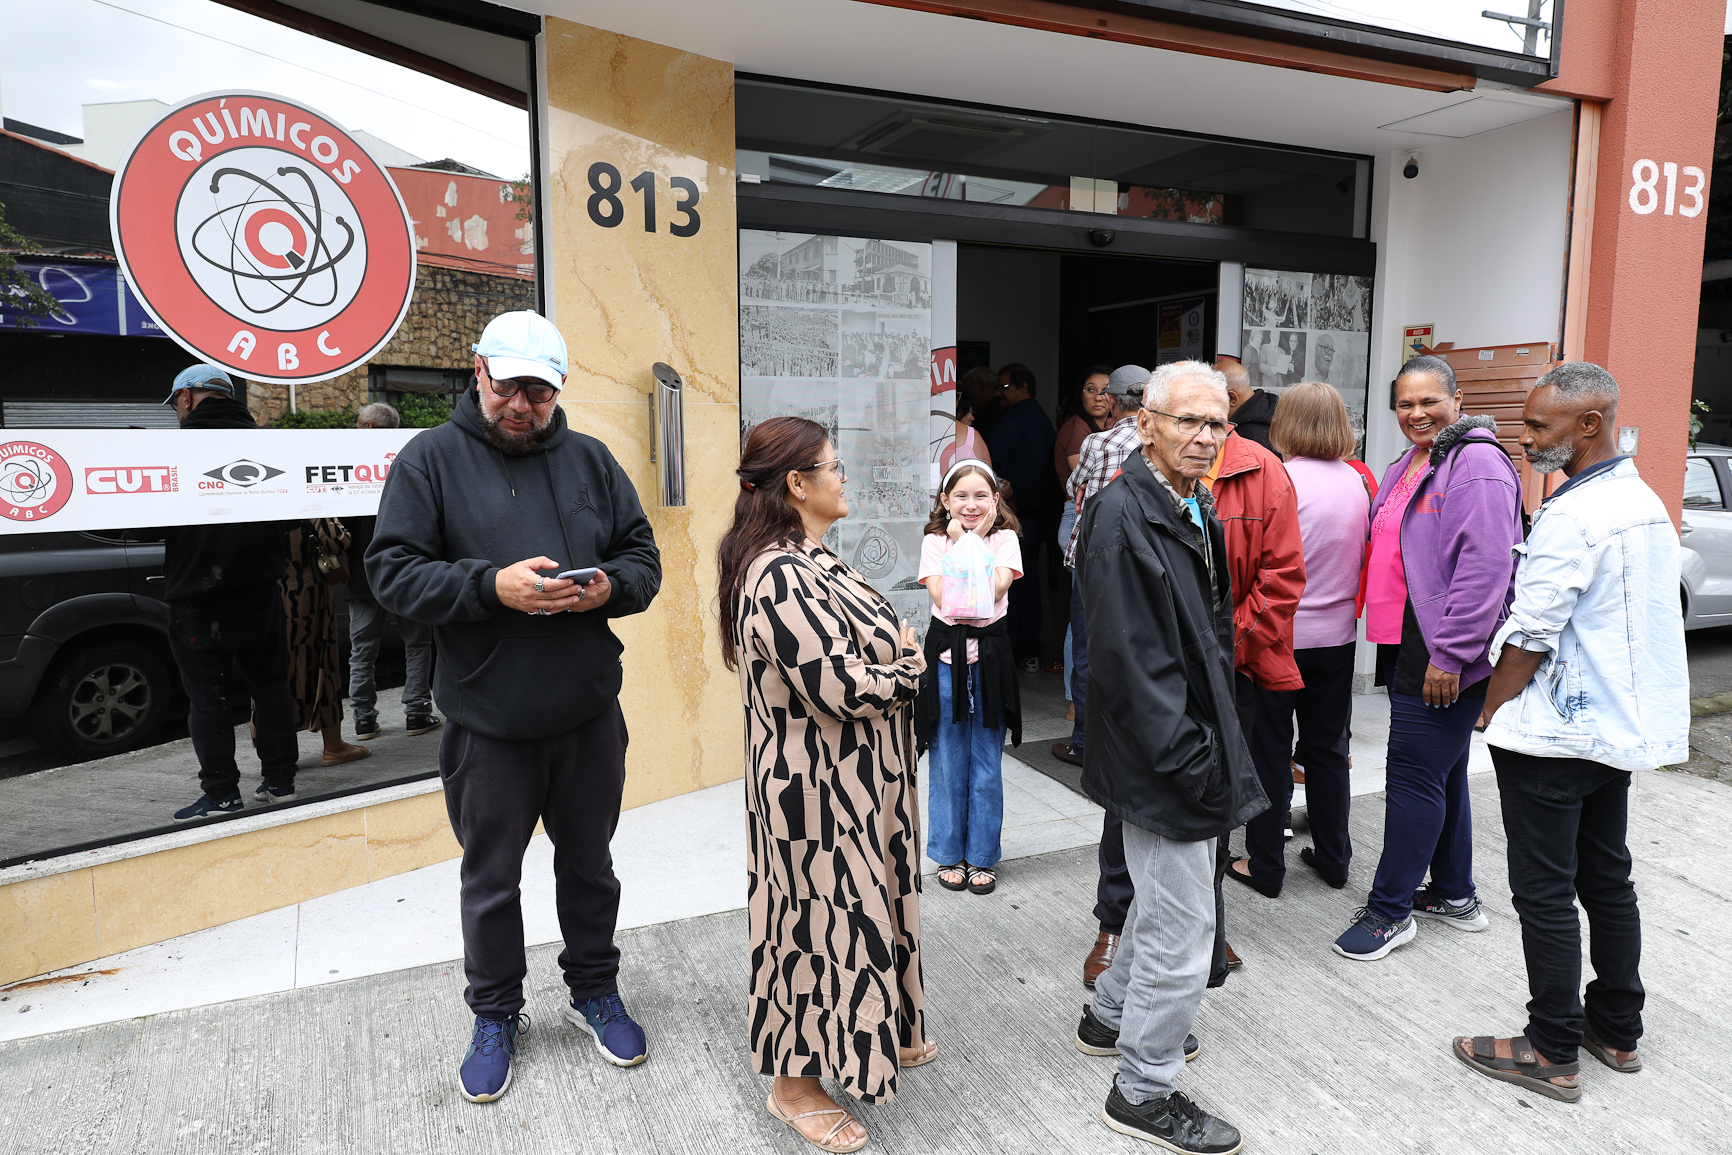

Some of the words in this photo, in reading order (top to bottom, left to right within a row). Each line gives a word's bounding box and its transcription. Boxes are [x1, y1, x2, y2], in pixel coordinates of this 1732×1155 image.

[168, 98, 361, 184] QUÍMICOS
[1628, 158, 1706, 218] 813
[586, 161, 701, 238] 813
[0, 444, 54, 464] UÍMICOS
[86, 469, 168, 493] CUT
[171, 465, 179, 492] BRASIL
[305, 464, 390, 484] FETQU
[198, 481, 225, 490] CNQ
[1425, 905, 1447, 913] FILA
[1383, 925, 1399, 941] FILA
